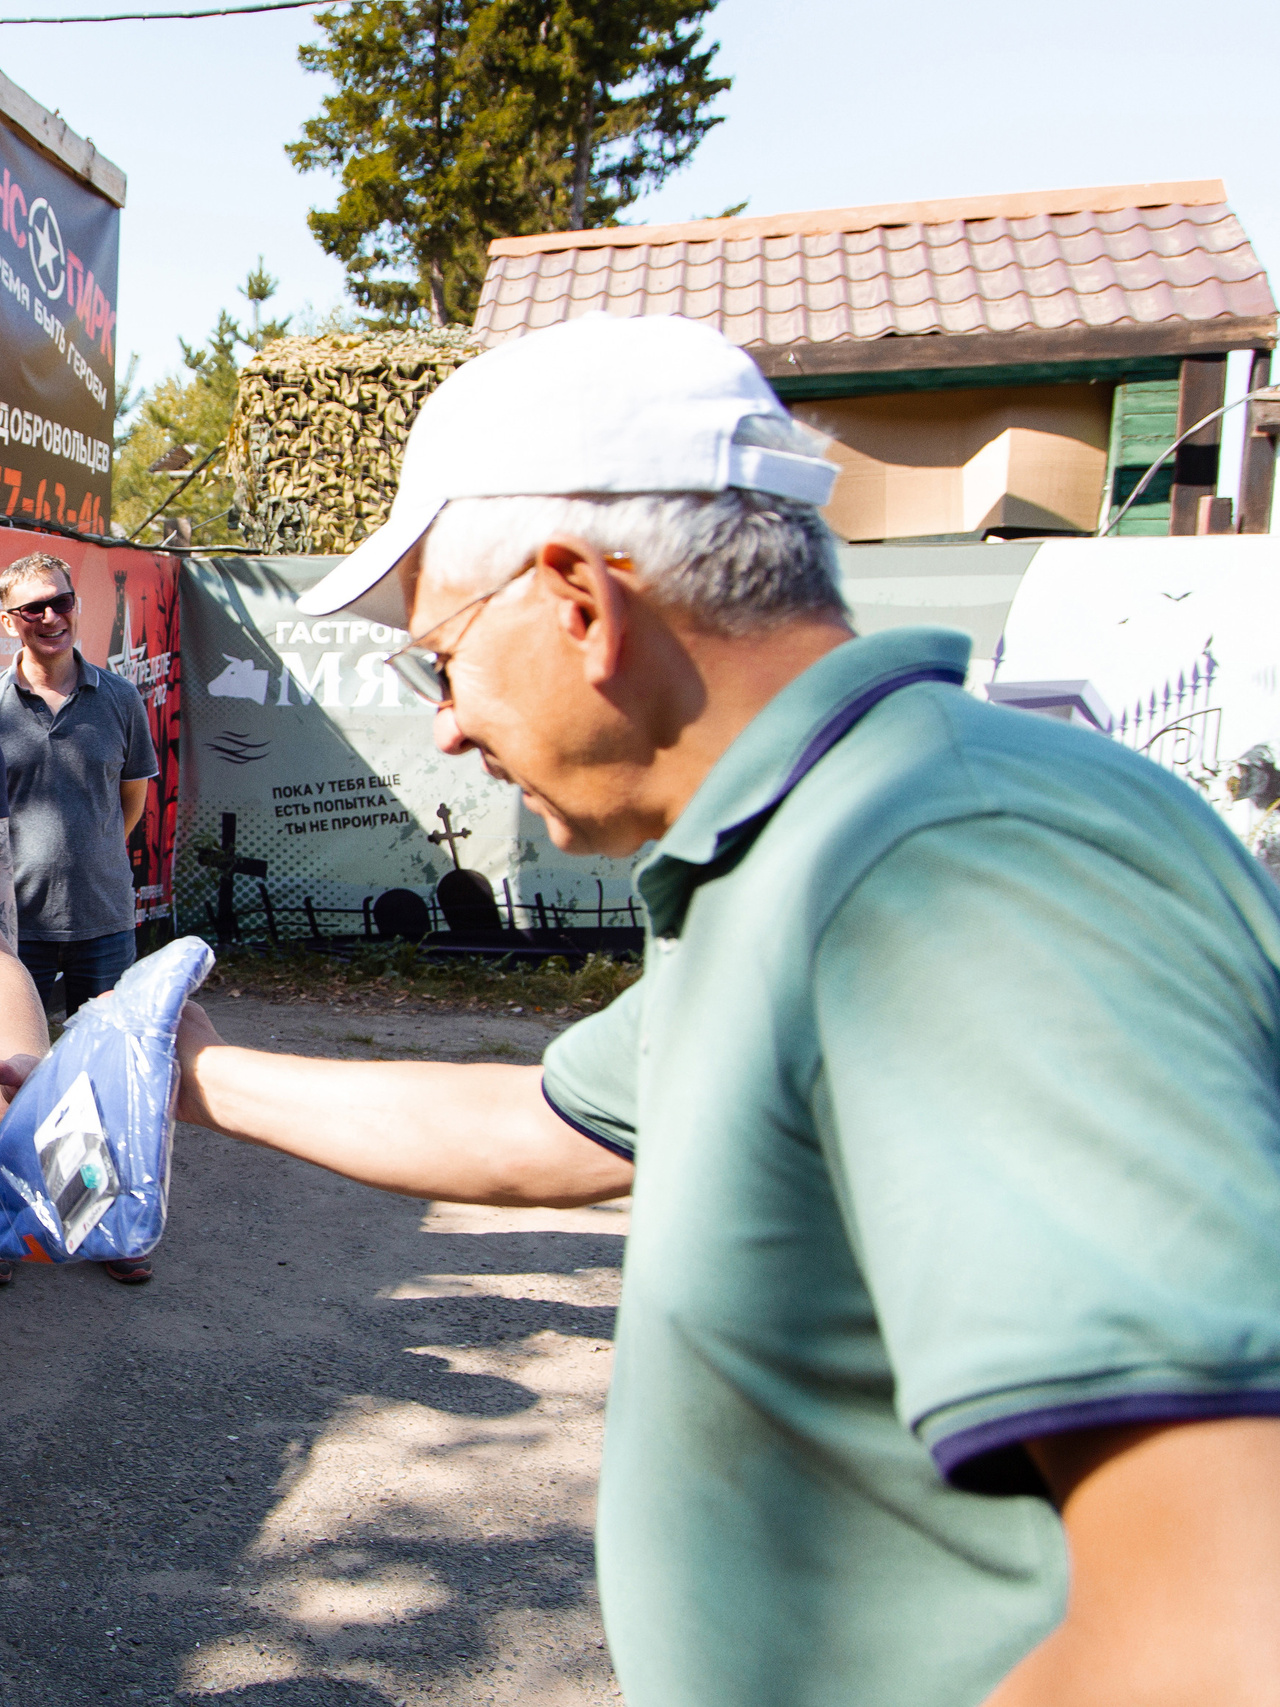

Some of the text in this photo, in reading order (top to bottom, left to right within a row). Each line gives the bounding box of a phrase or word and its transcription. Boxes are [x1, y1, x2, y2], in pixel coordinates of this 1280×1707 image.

[67, 249, 116, 367] ПАРК
[34, 296, 66, 354] БЫТЬ
[67, 341, 108, 410] ГЕРОЕМ
[272, 774, 401, 800] ПОКА У ТЕБЯ ЕЩЕ
[274, 802, 311, 818] ЕСТЬ
[313, 794, 388, 814] ПОПЫТКА
[284, 810, 410, 836] ТЫ НЕ ПРОИГРАЛ
